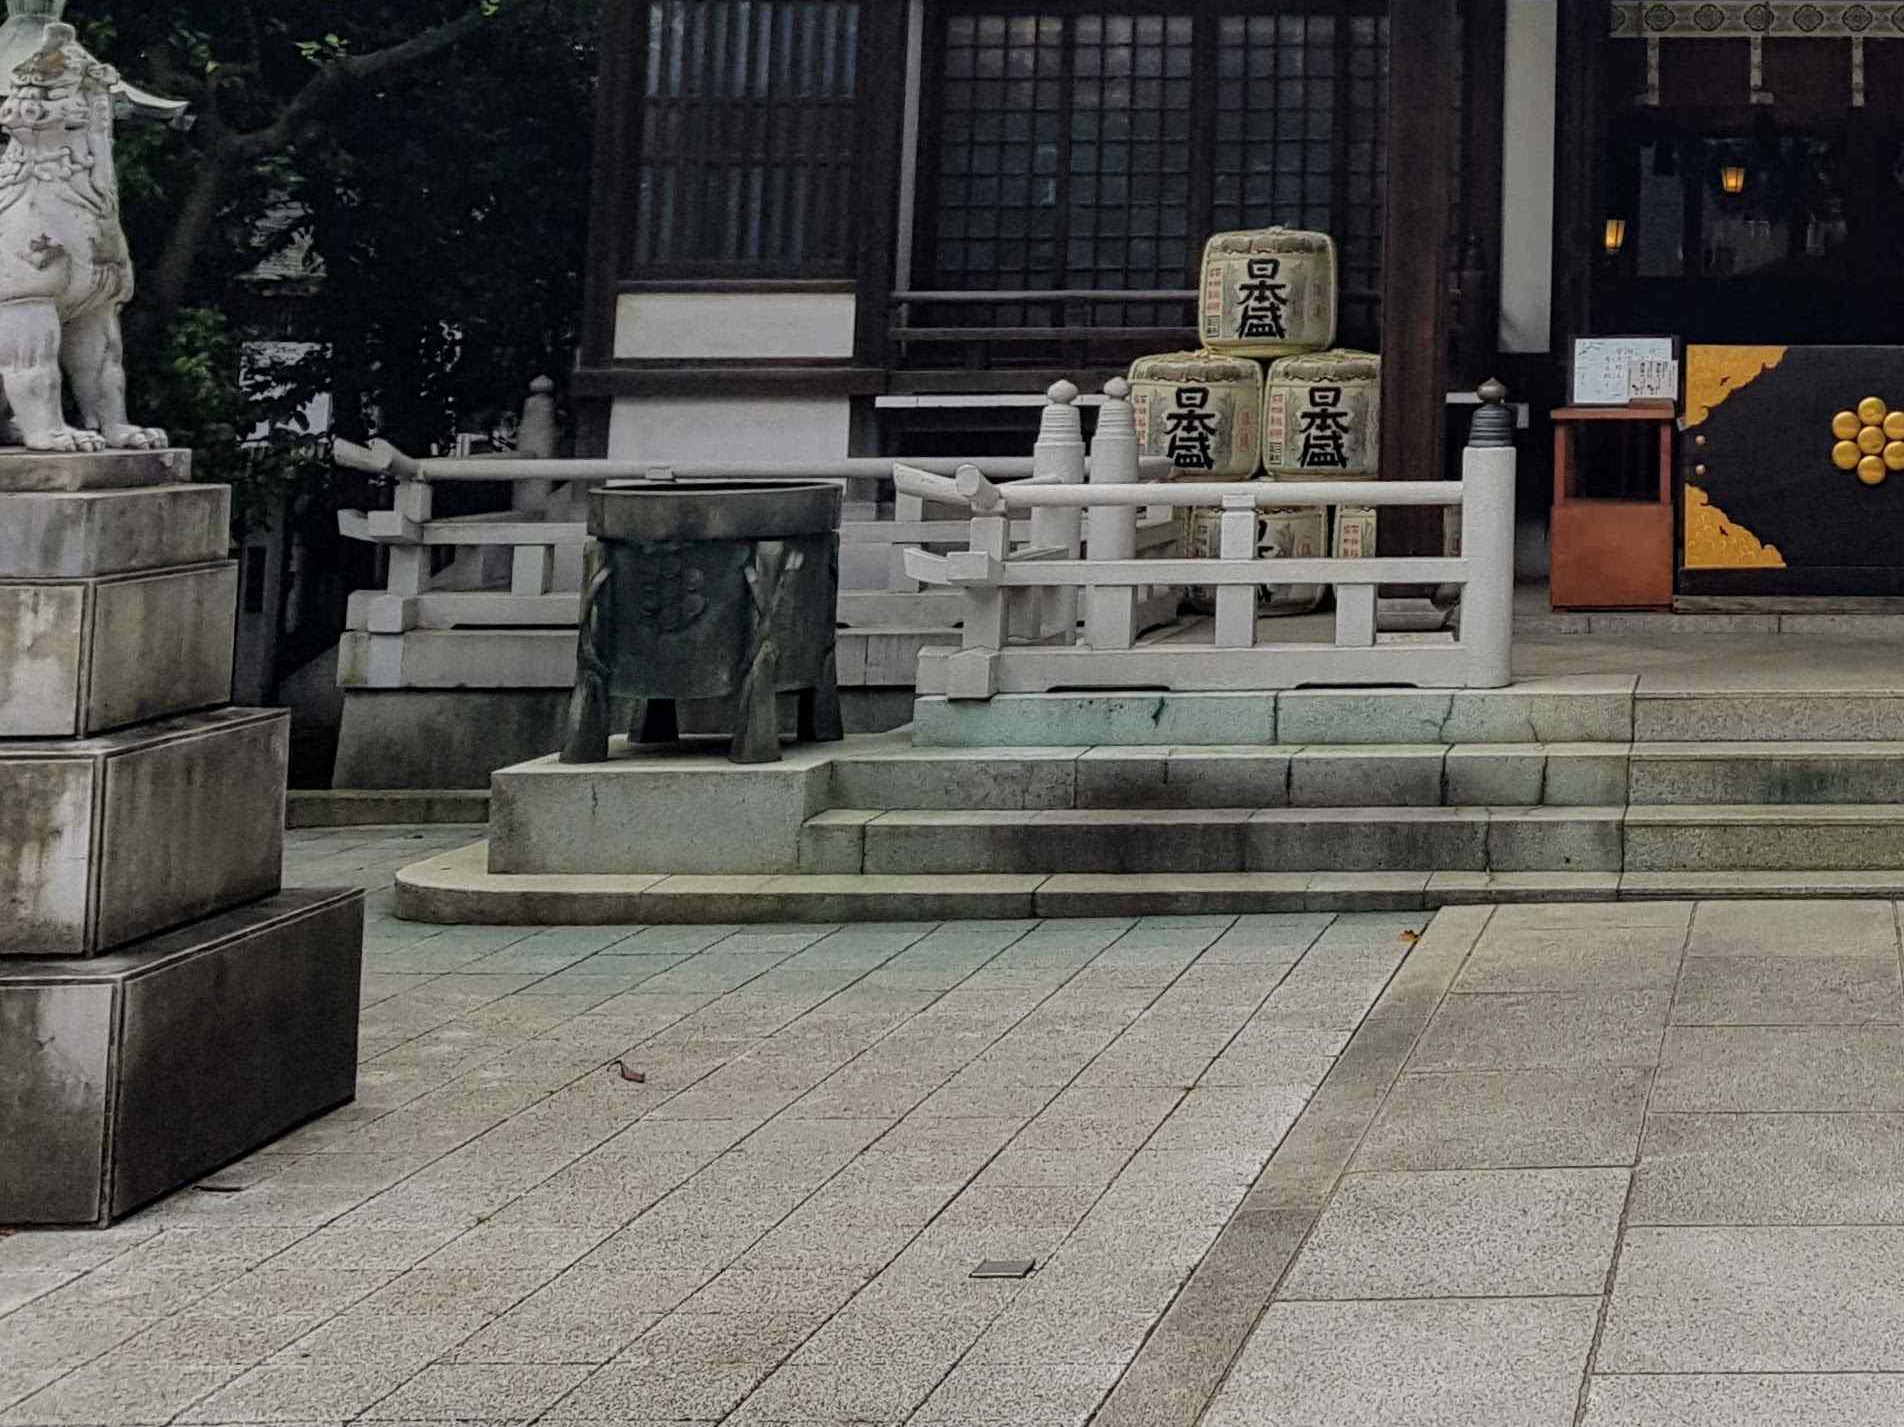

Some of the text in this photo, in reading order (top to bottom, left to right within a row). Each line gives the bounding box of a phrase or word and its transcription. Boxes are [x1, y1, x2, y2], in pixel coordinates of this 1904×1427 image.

[1237, 258, 1289, 339] 日本盛
[1164, 387, 1217, 470] 日本盛
[1299, 387, 1350, 469] 日本盛
